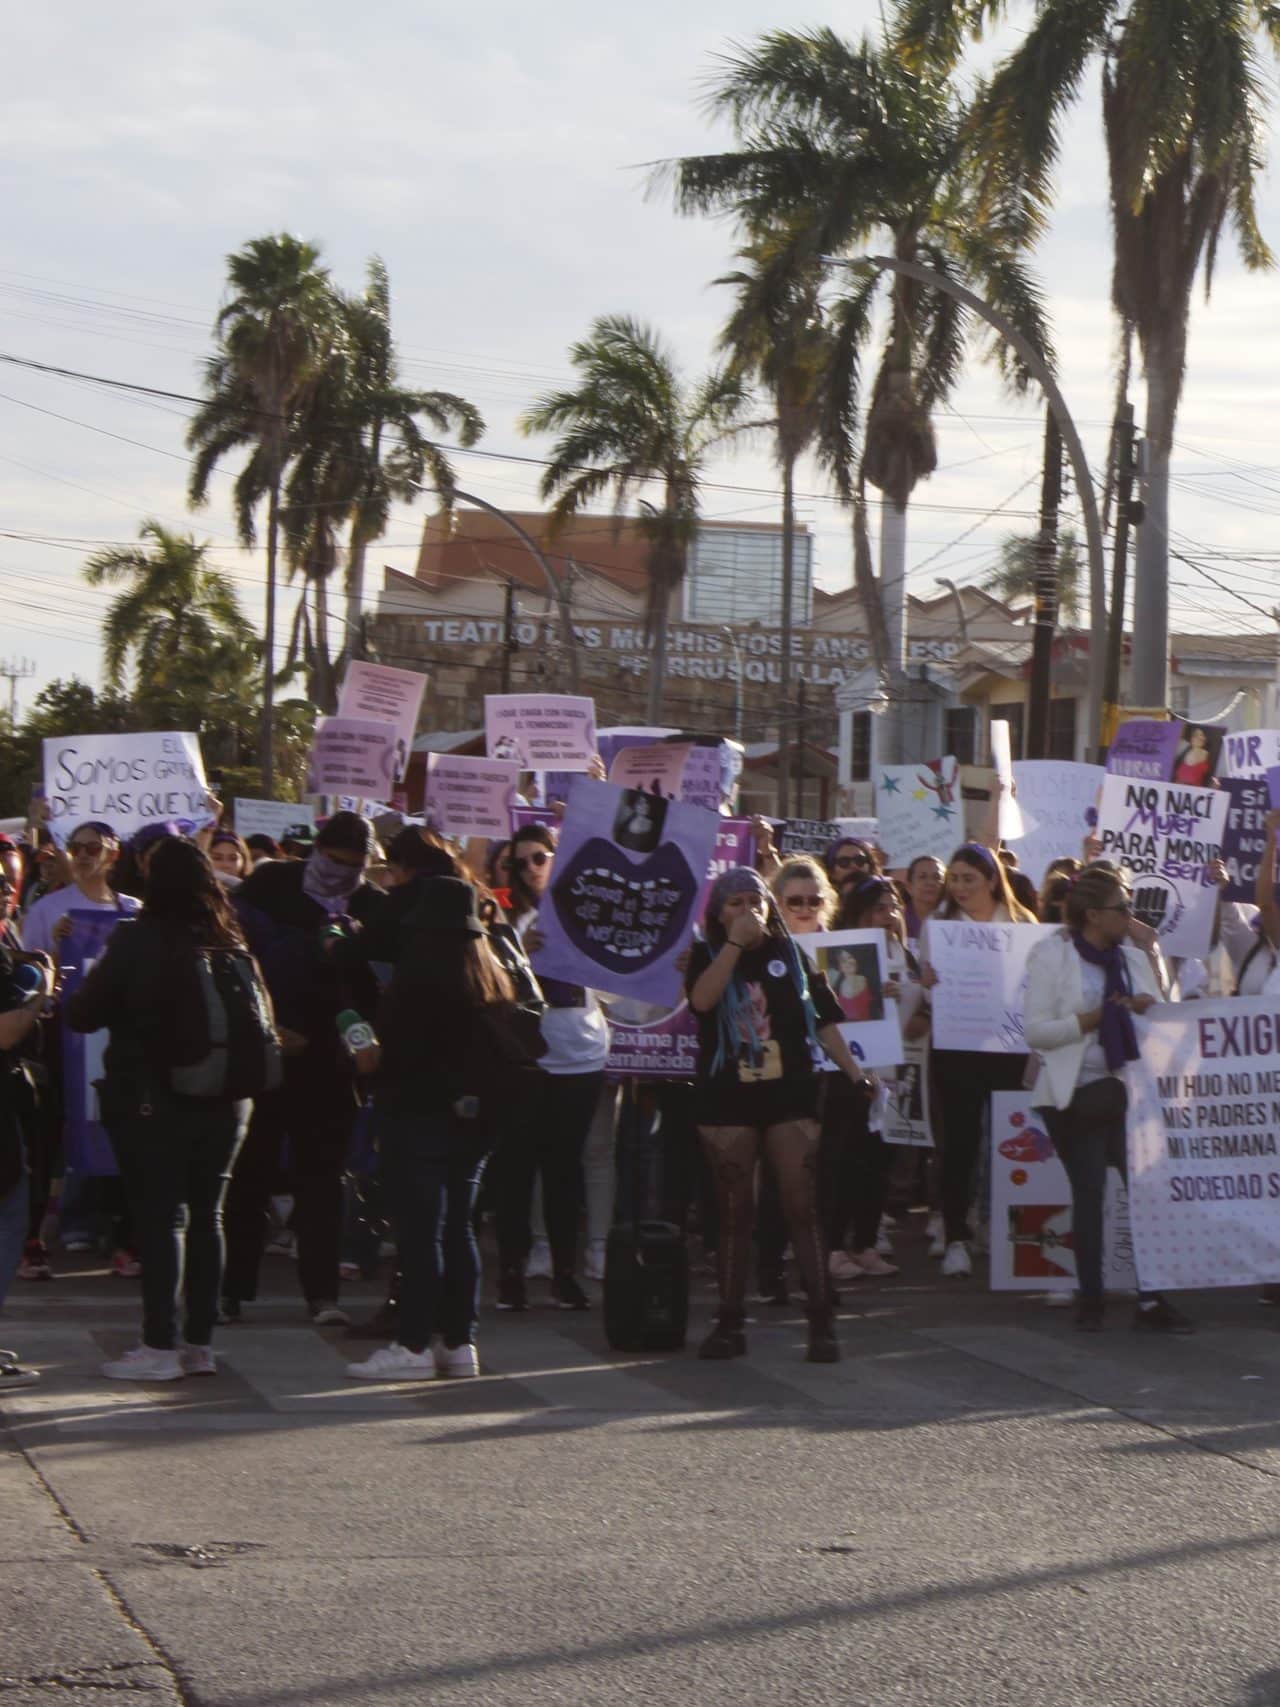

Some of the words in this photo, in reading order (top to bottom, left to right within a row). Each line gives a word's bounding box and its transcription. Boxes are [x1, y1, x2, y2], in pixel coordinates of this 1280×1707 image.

[424, 620, 537, 646] TEATO
[1228, 735, 1262, 768] POR
[51, 795, 81, 817] DE
[90, 793, 132, 814] LAS
[138, 792, 179, 817] QUE
[1126, 785, 1159, 809] NO
[1166, 790, 1216, 819] NACÍ
[1102, 830, 1158, 859] PARA
[1120, 856, 1157, 873] POR
[942, 926, 1013, 952] VIANEY
[605, 1049, 696, 1070] eminicida
[1157, 1076, 1179, 1099] MI
[1184, 1074, 1222, 1099] HIJO
[1228, 1072, 1253, 1096] NO
[1161, 1106, 1192, 1130] MIS
[1198, 1101, 1267, 1128] PADRES
[1167, 1137, 1186, 1159] MI
[1188, 1133, 1276, 1159] HERMANA
[1170, 1175, 1263, 1202] SOCIEDAD
